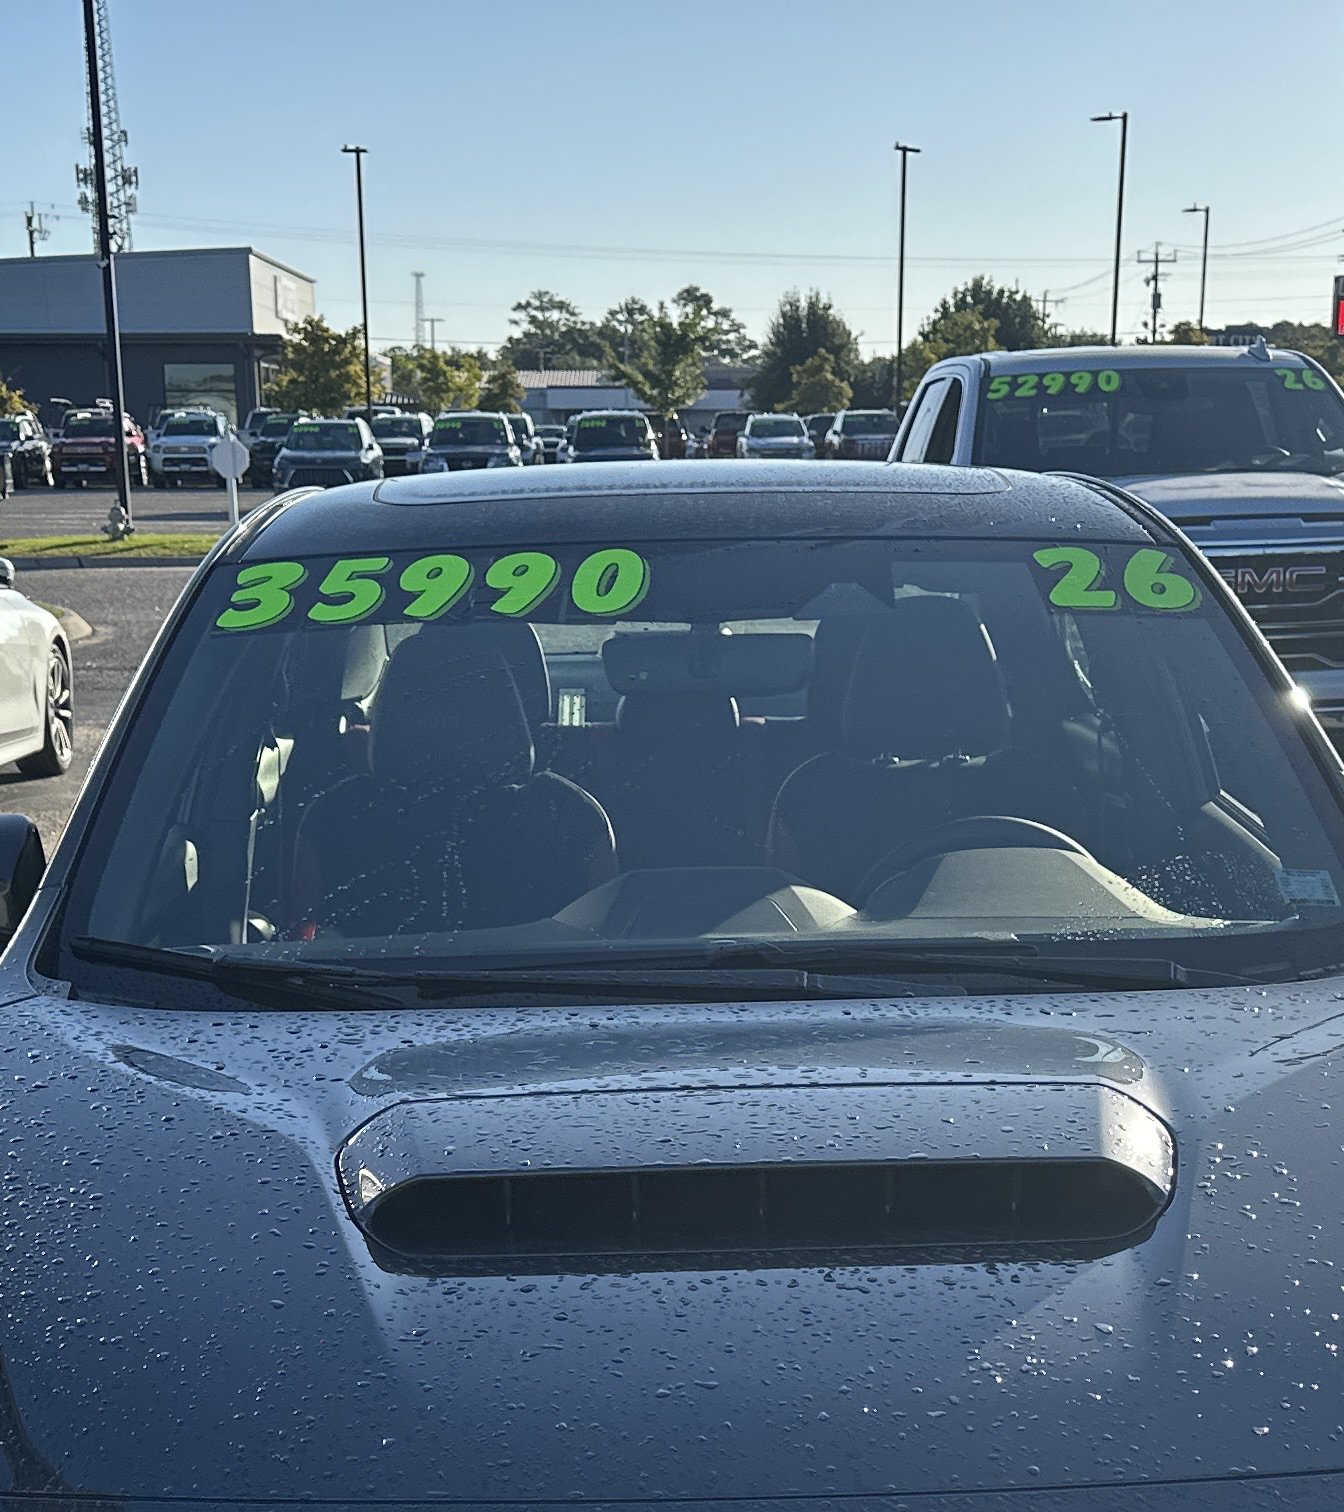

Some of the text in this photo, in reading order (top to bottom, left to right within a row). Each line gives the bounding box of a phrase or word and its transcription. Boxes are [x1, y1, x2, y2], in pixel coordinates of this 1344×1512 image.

[987, 368, 1326, 400] 52990 26
[215, 546, 1202, 631] 35990 26
